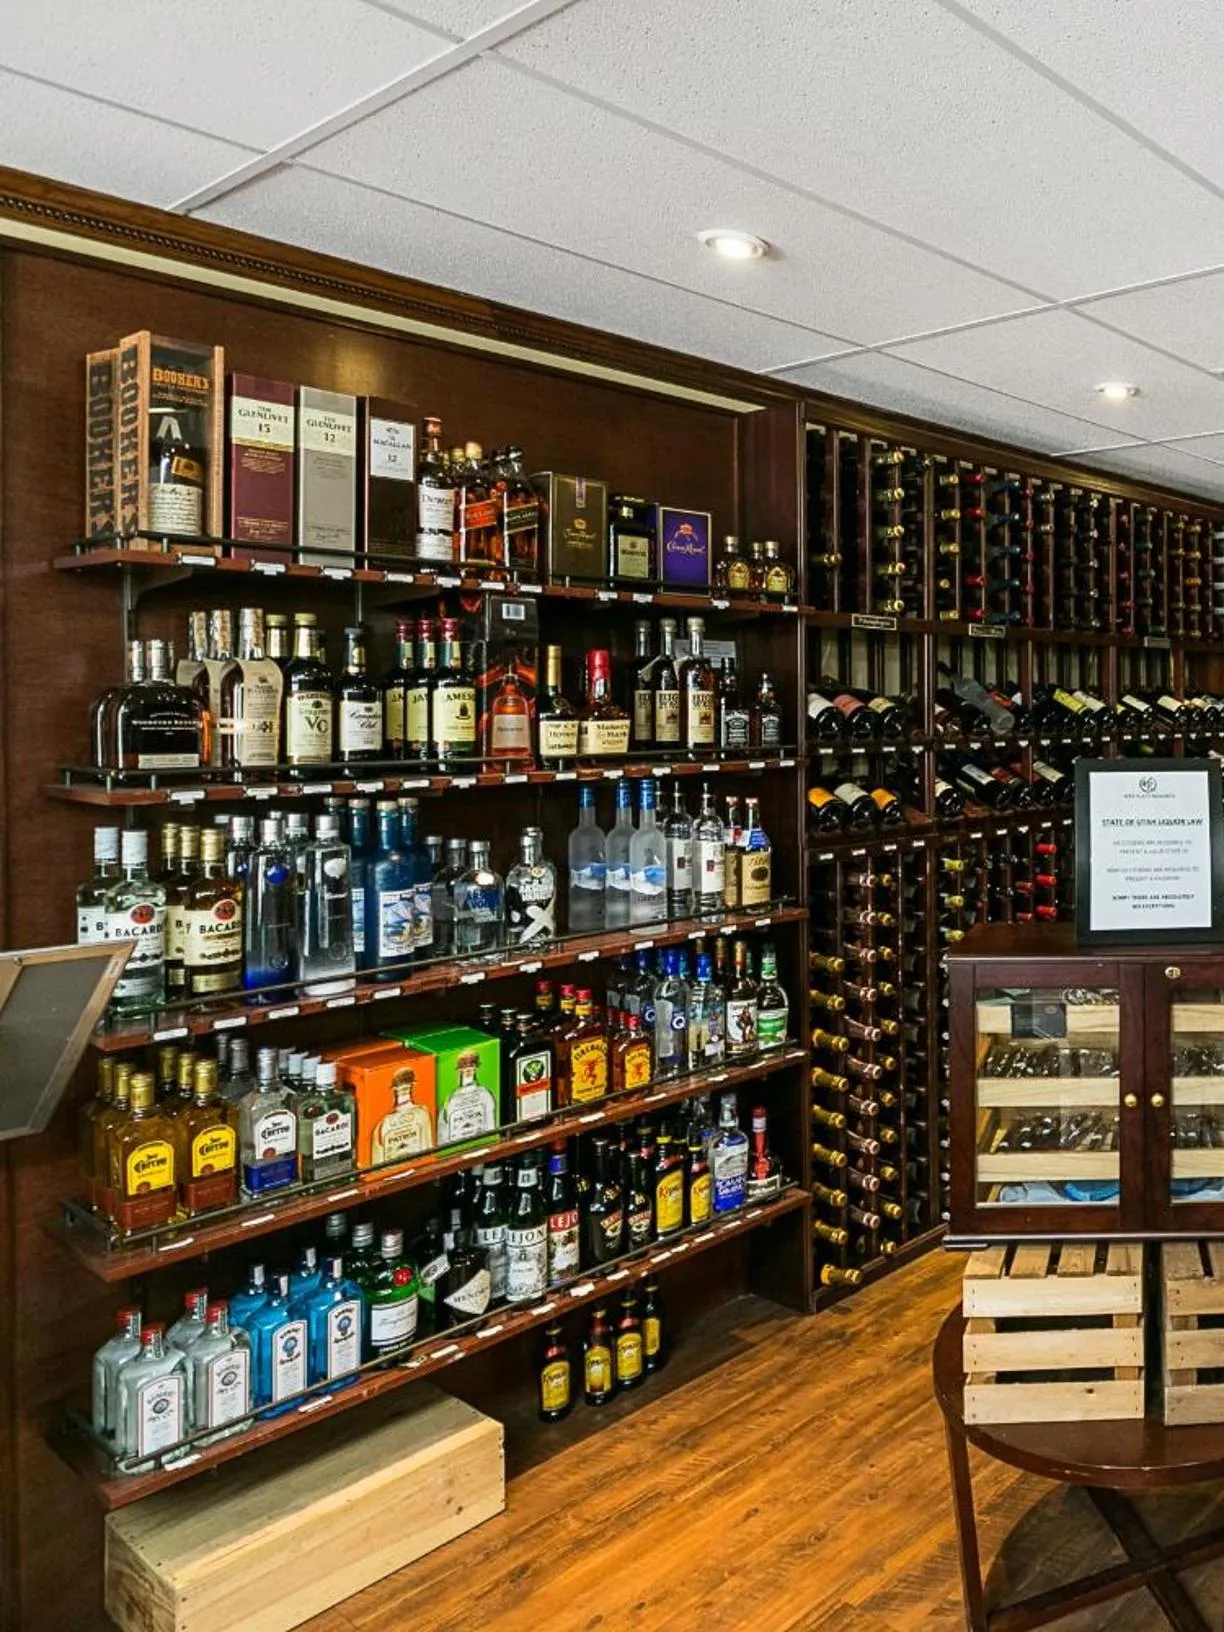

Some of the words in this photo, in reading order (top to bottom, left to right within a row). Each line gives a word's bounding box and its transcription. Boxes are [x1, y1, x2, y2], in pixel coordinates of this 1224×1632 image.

[238, 409, 289, 424] GLENLIVET
[258, 423, 271, 433] 15
[324, 432, 336, 443] 12
[387, 453, 397, 463] 12
[1102, 819, 1123, 827] STATE
[200, 921, 240, 934] BACAR
[550, 1212, 579, 1228] LEJO
